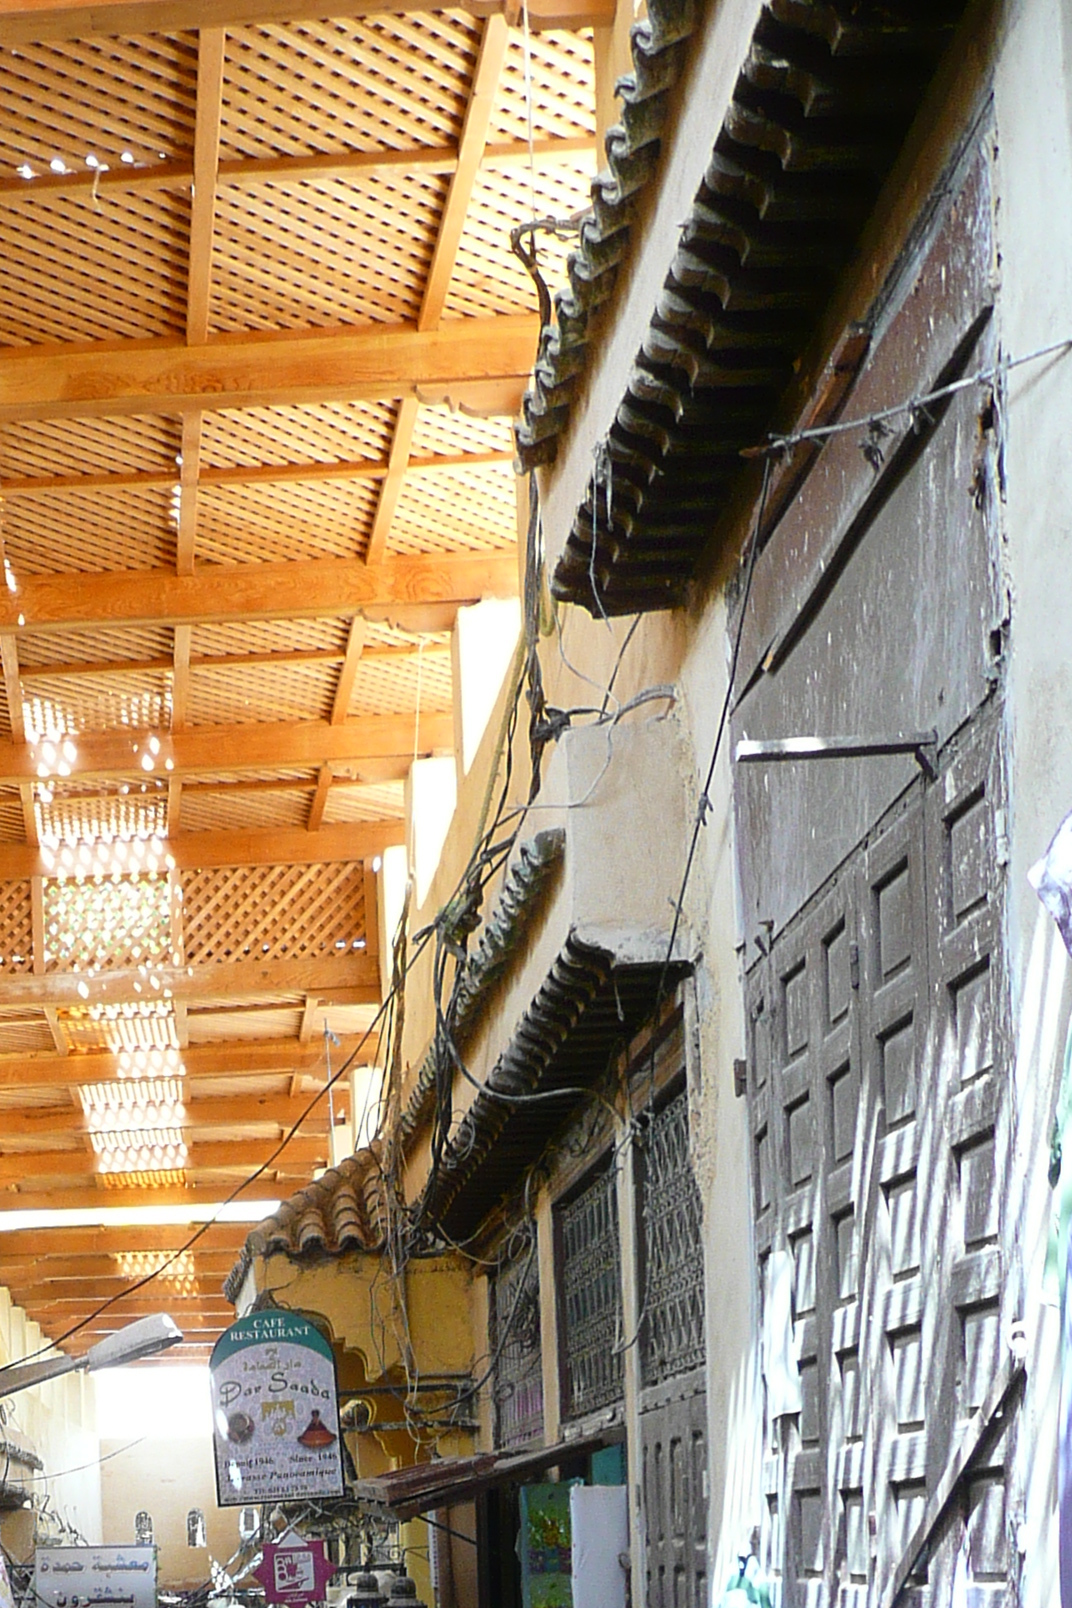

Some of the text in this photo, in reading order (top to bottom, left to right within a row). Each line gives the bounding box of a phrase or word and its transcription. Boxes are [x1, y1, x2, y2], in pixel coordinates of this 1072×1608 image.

[253, 1317, 286, 1329] CAFE
[229, 1326, 310, 1342] RESTAURANT
[219, 1371, 331, 1408] Dar Saada
